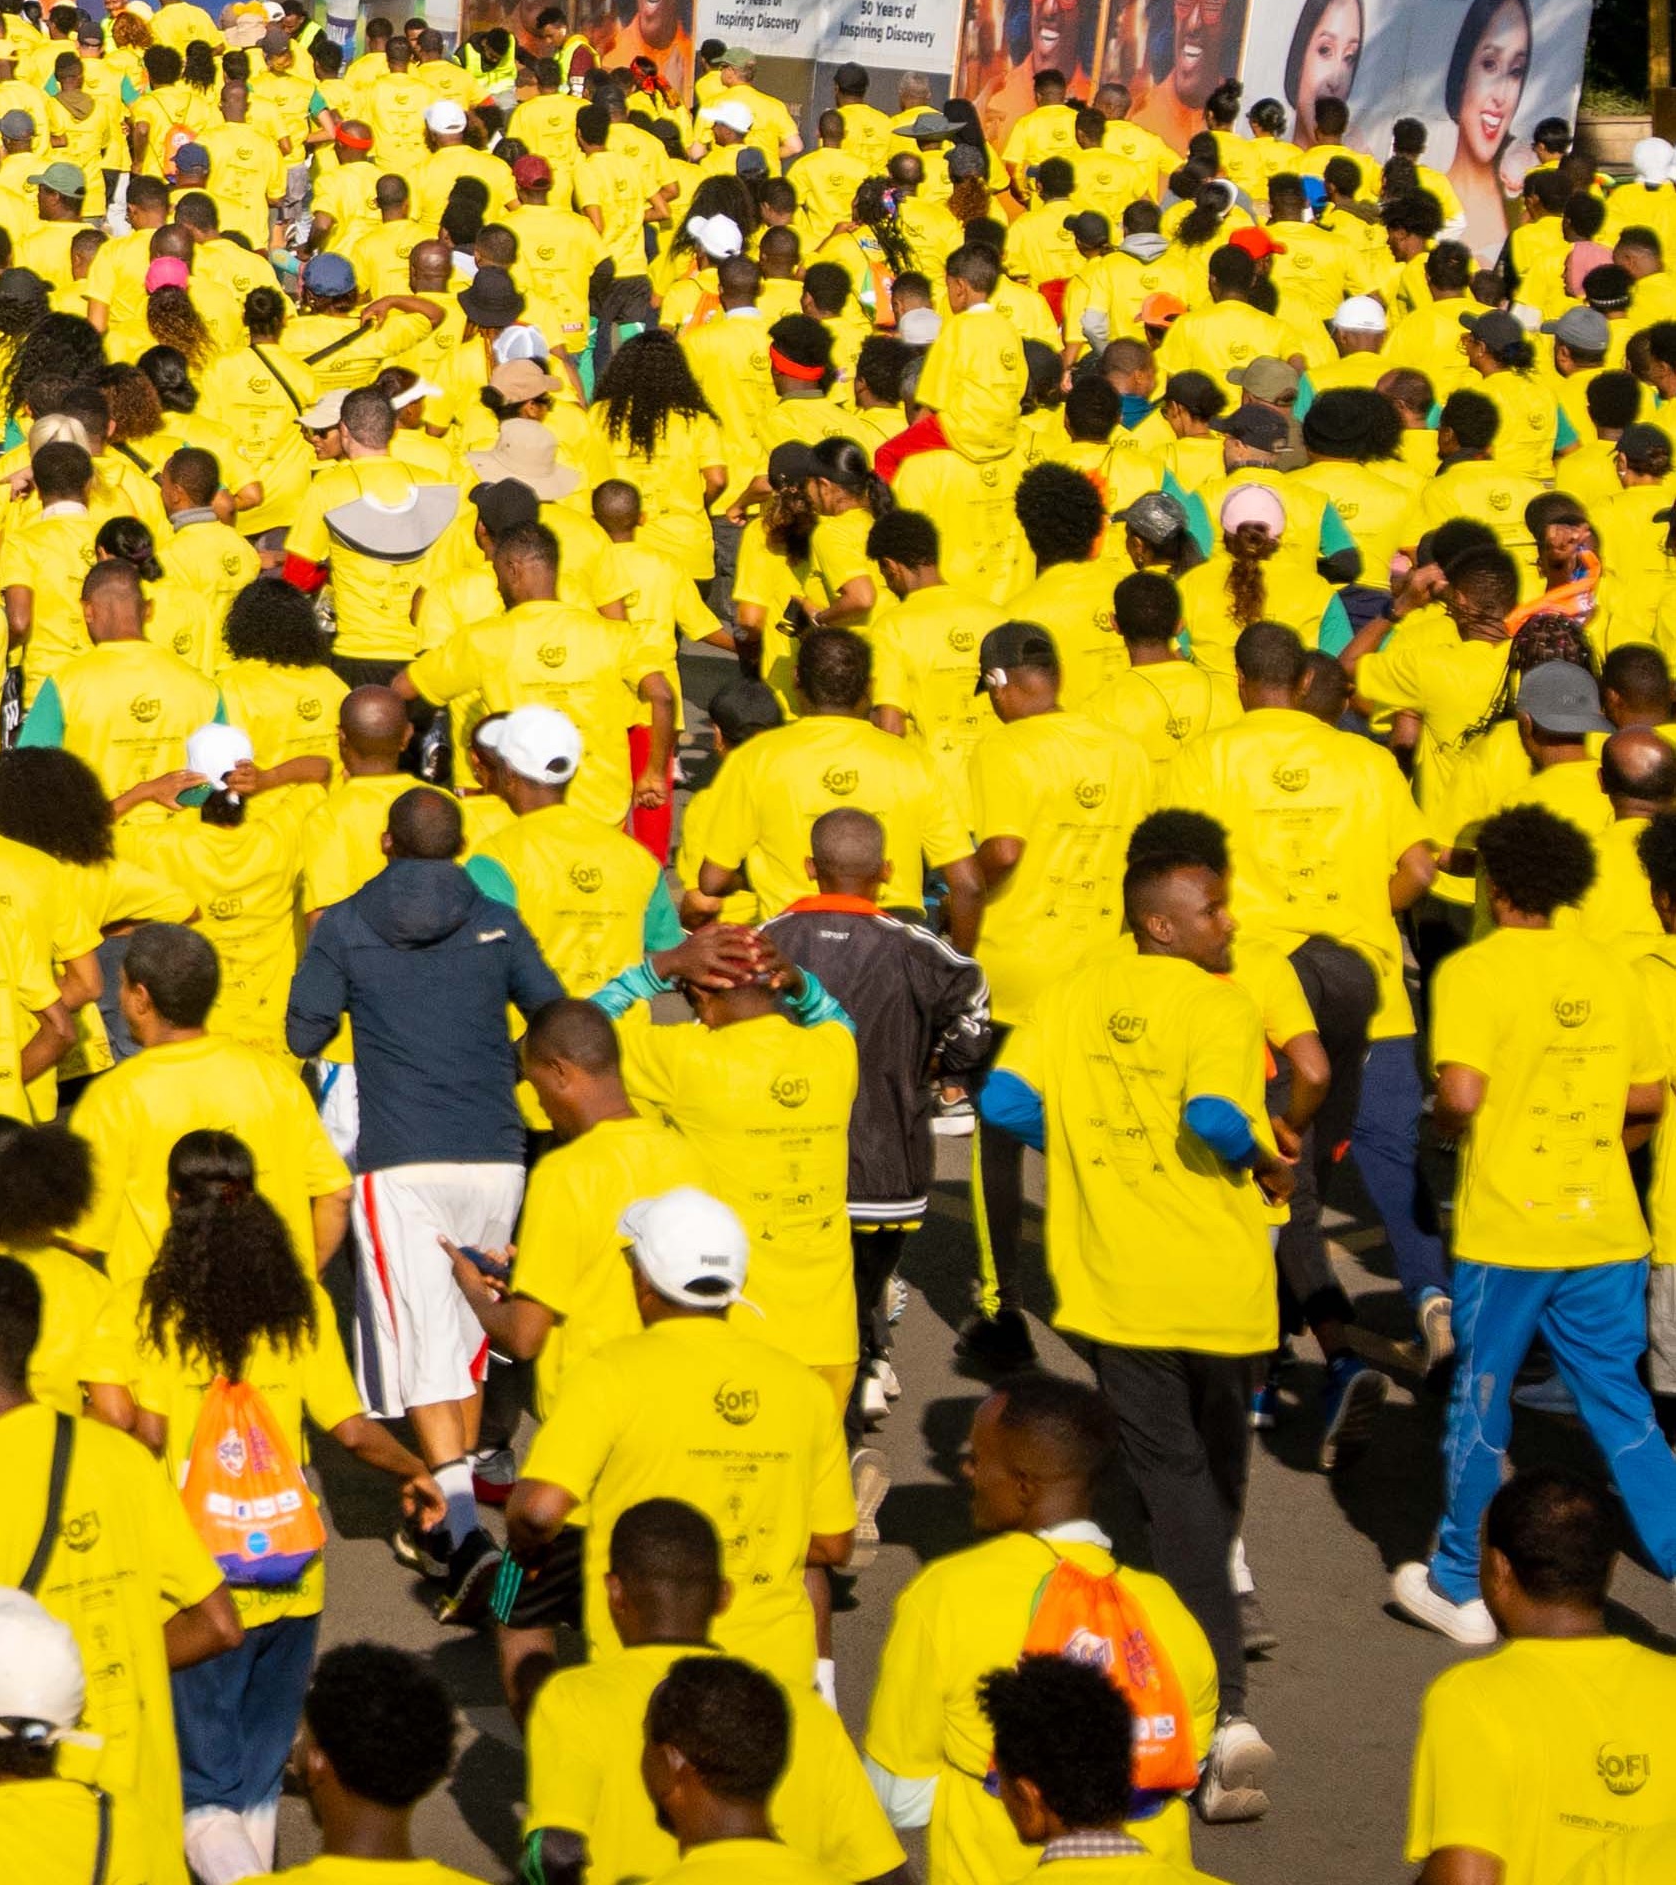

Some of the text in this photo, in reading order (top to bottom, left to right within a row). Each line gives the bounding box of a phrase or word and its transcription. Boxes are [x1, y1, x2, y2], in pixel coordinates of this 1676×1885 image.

[861, 0, 916, 19] 50 Years of
[716, 11, 801, 33] Inspiring Discovery
[839, 21, 935, 47] Inspiring Discovery
[130, 699, 161, 716] SOFI
[822, 770, 859, 787] SOFI
[1272, 768, 1310, 785] SOFI
[1074, 785, 1106, 801] SOFI
[570, 869, 602, 885] SOFI
[208, 898, 243, 917] SOFI
[1554, 1000, 1590, 1018] SOFI
[1107, 1013, 1147, 1033] SOFI
[770, 1079, 810, 1097] SOFI
[714, 1391, 760, 1413] SOFI
[1598, 1753, 1650, 1777] SOFI
